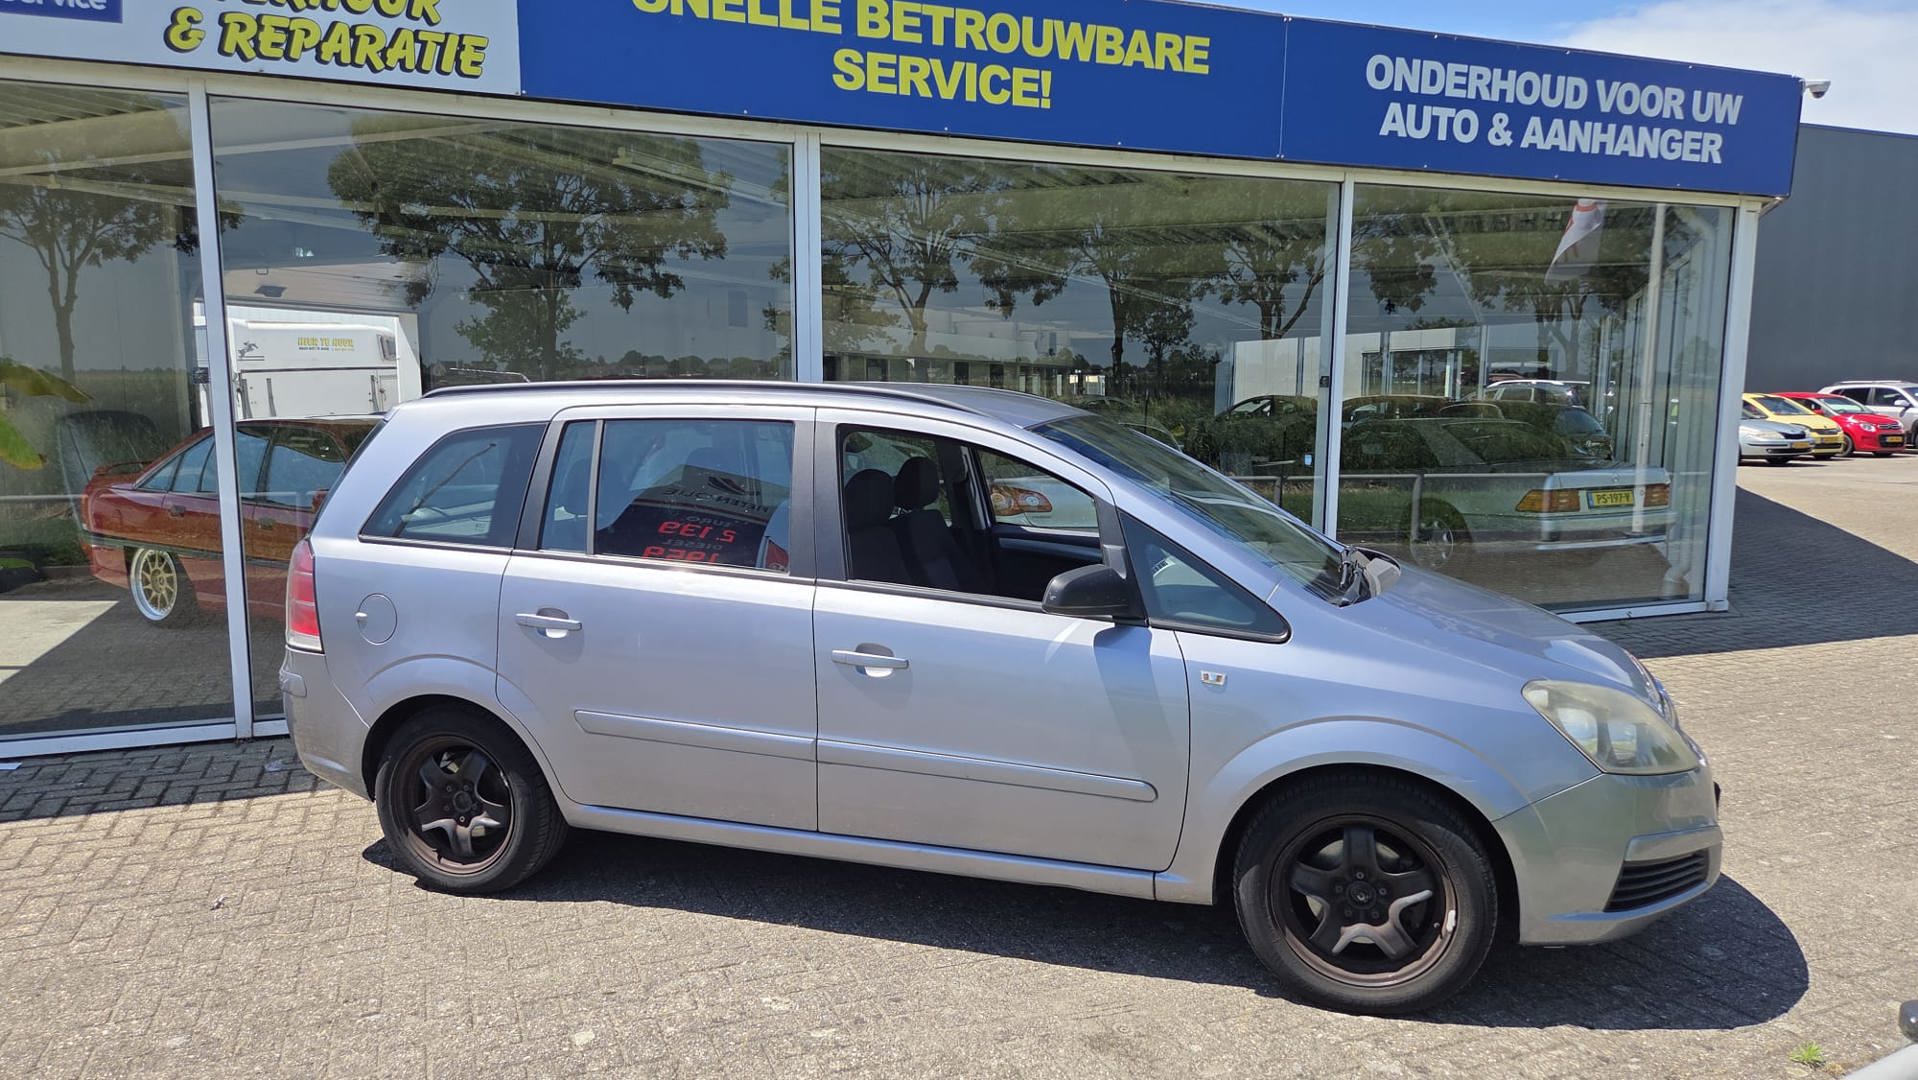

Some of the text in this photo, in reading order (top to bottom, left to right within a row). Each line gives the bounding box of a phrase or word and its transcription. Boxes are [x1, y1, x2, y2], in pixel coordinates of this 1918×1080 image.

[164, 7, 206, 53] &
[217, 12, 490, 79] REPARATIE
[857, 0, 1211, 75] BETROUWBARE
[832, 48, 1053, 109] SERVICE!
[1366, 54, 1743, 126] ONDERHOUD VOOR UW
[1379, 102, 1723, 164] AUTO & AANHANGER
